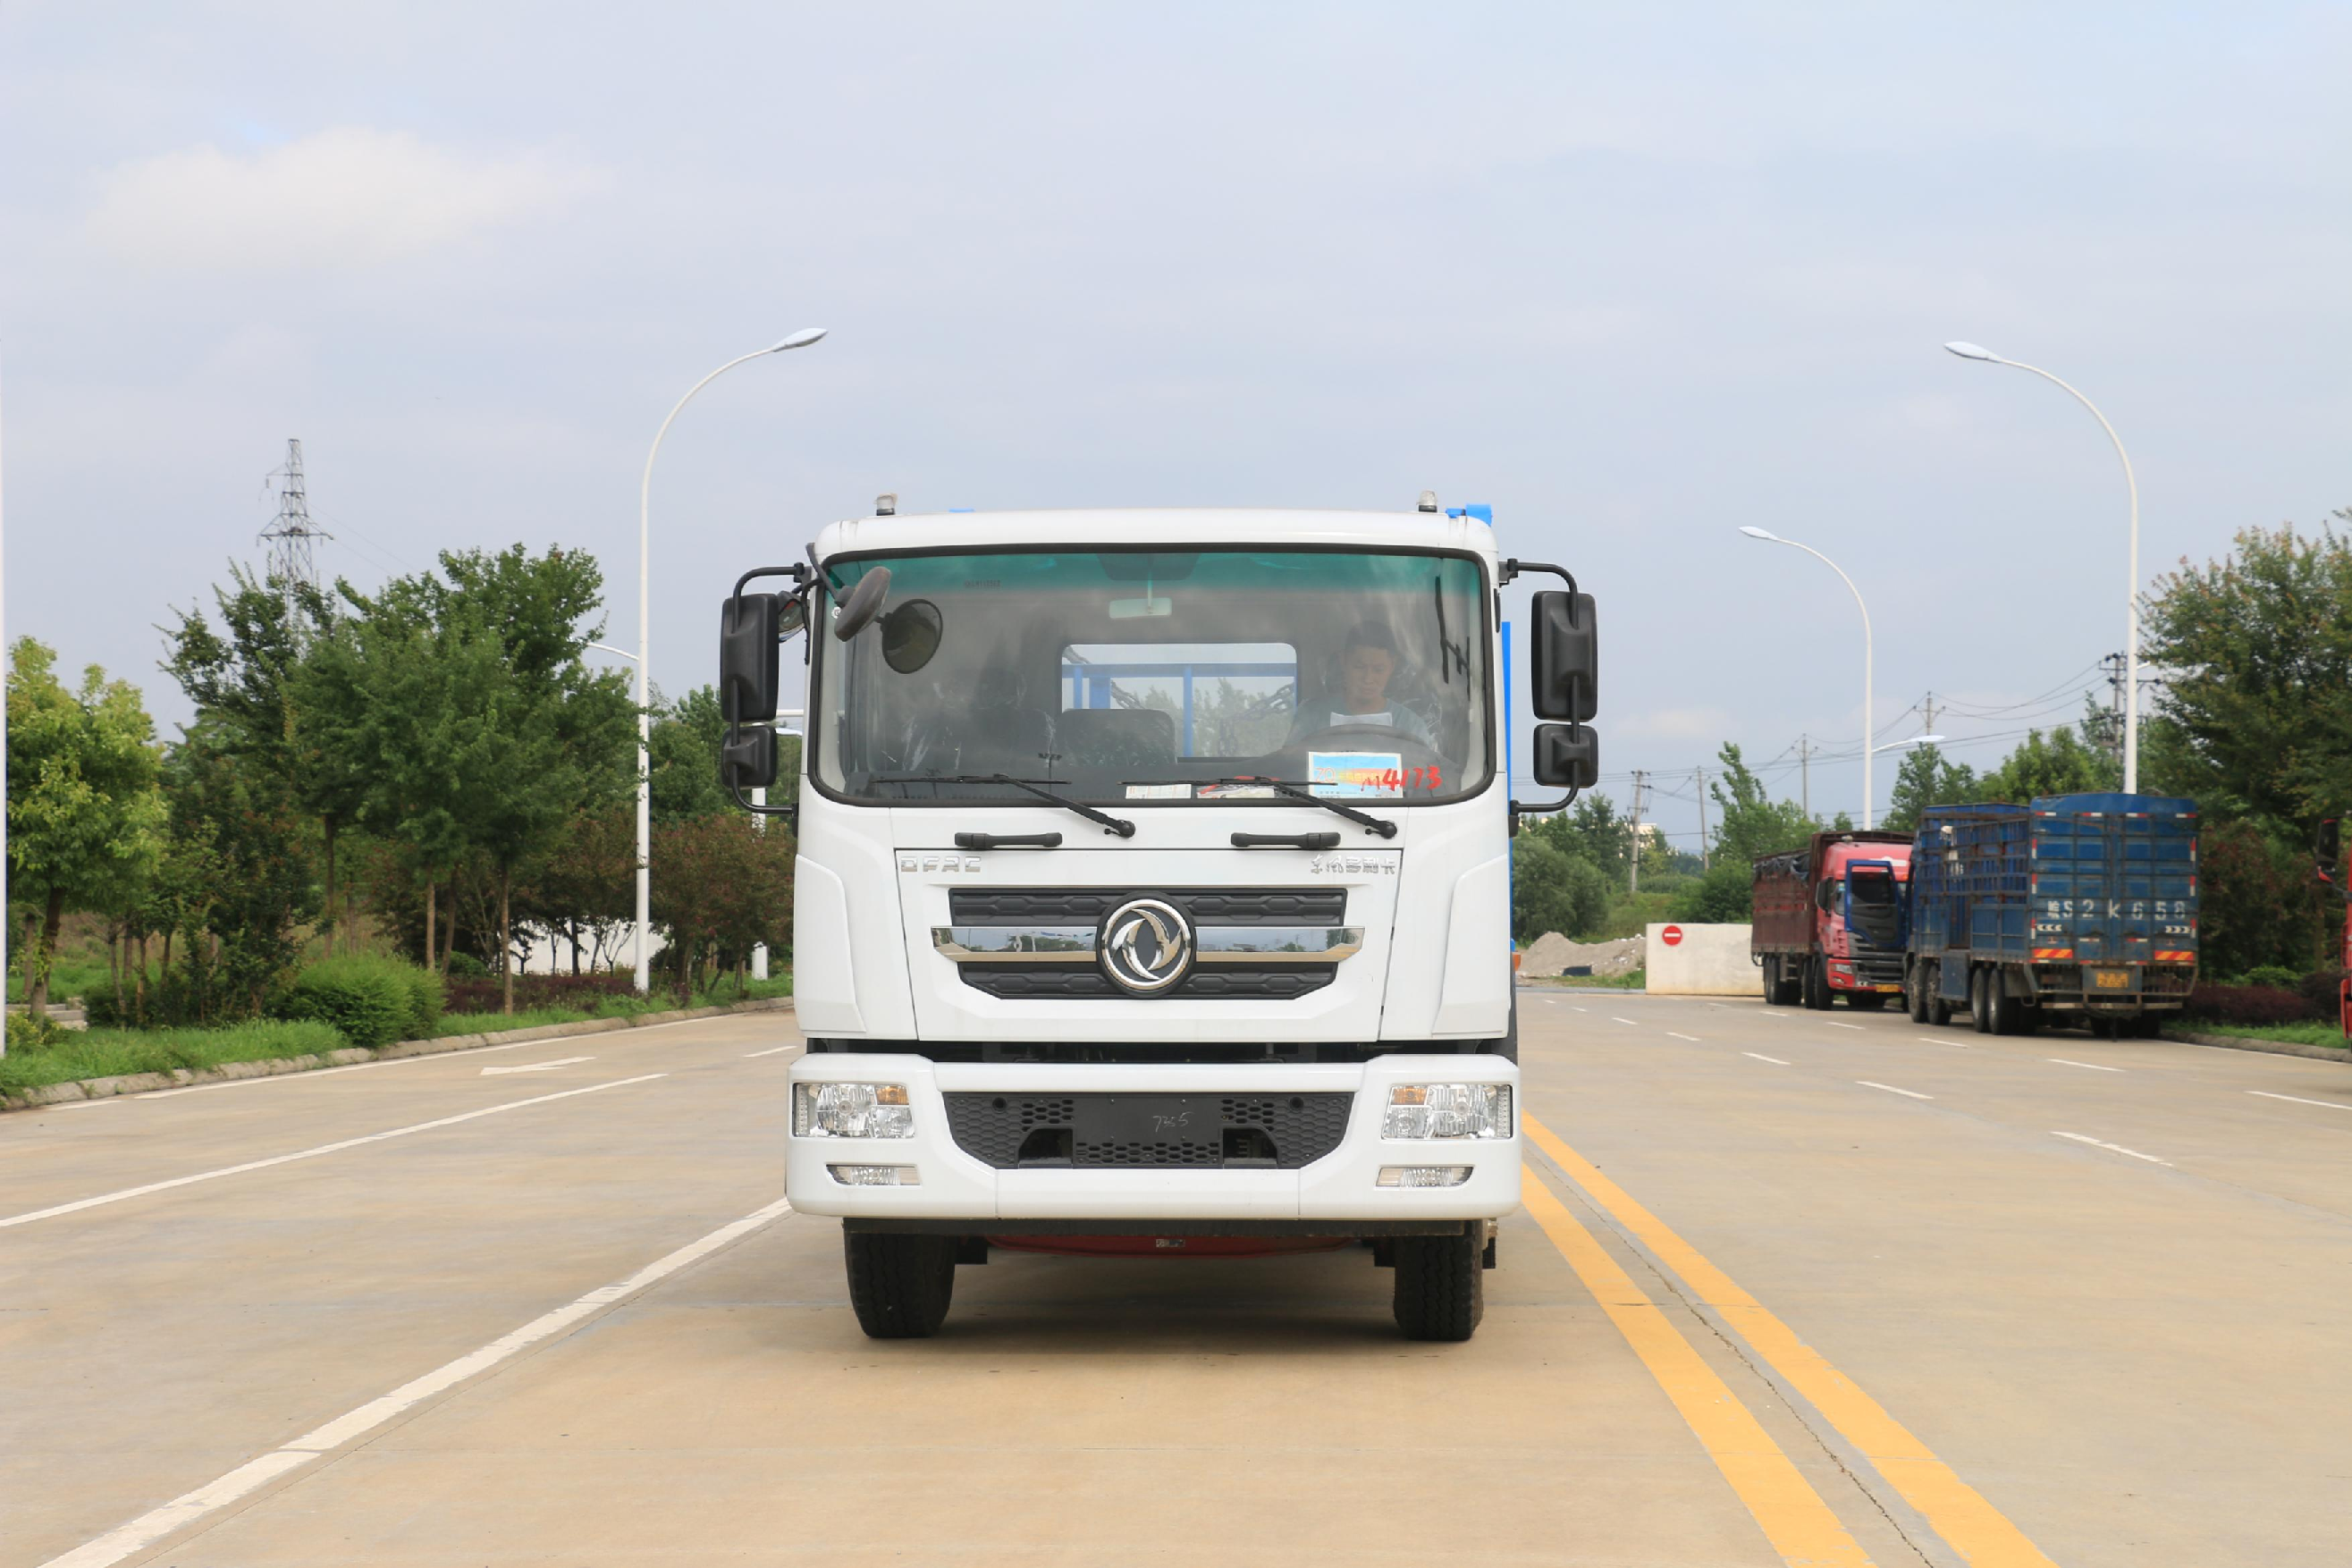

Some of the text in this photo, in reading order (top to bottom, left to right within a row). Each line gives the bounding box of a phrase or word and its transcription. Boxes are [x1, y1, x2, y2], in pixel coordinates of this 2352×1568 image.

[900, 856, 982, 873] DFAC
[1311, 854, 1396, 874] 东风多利卡
